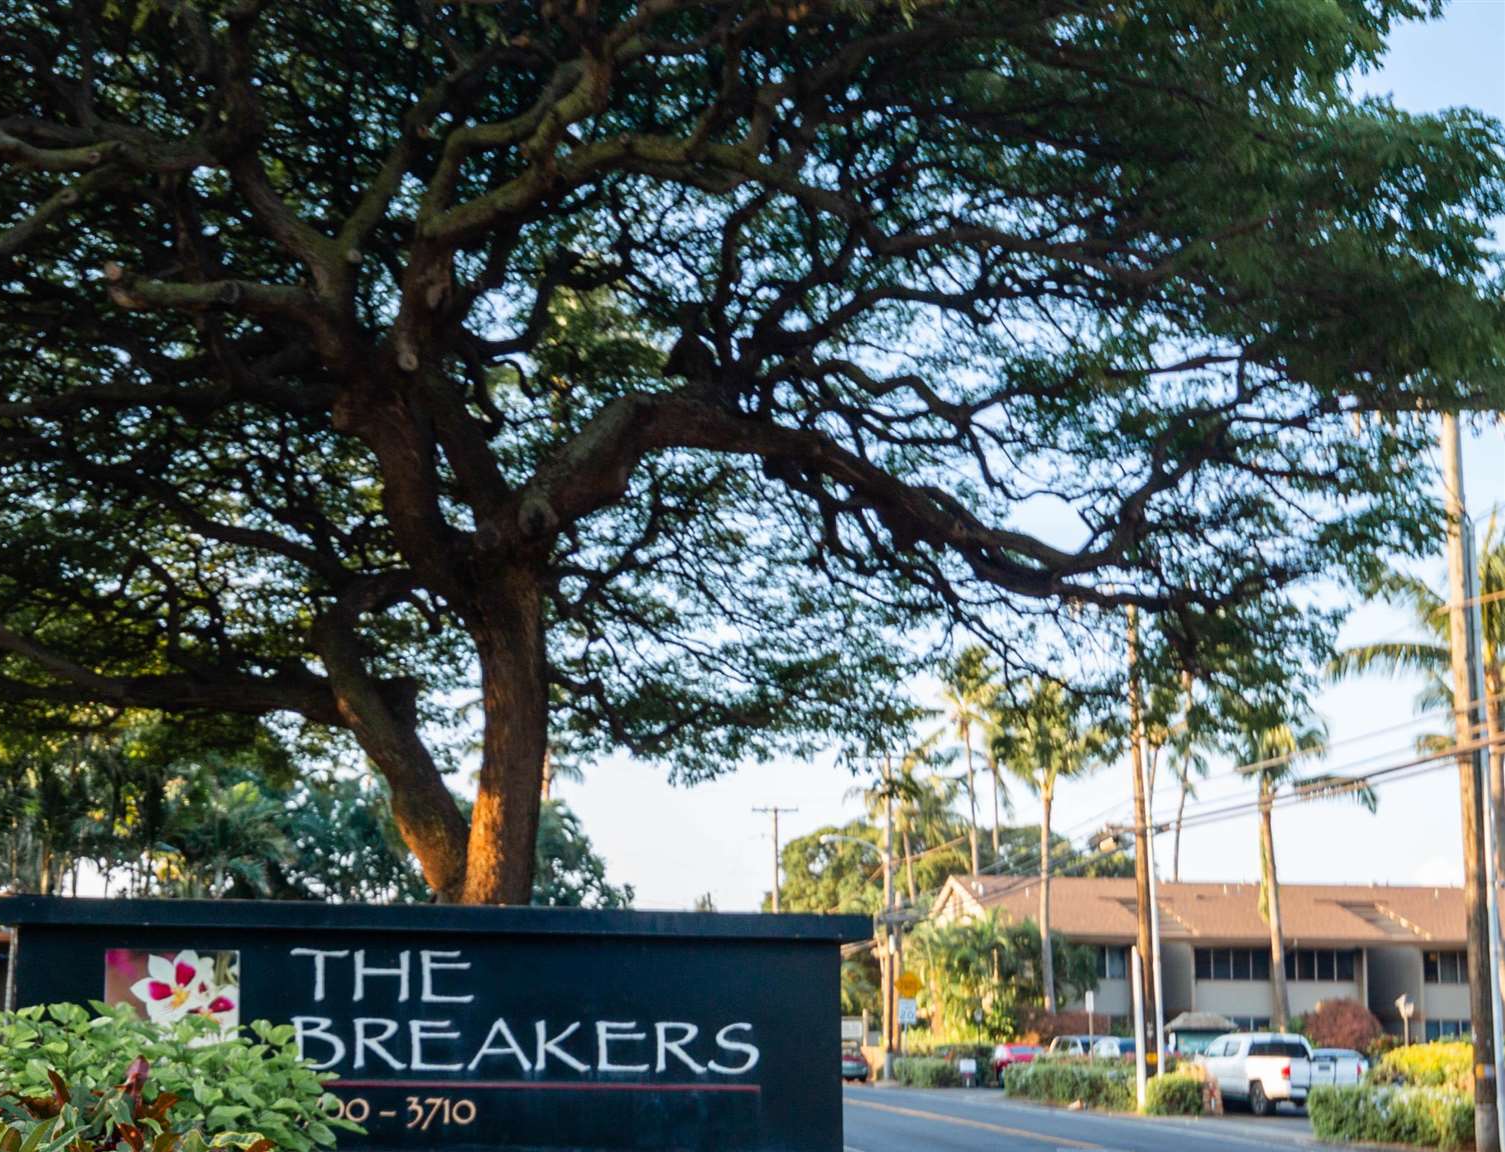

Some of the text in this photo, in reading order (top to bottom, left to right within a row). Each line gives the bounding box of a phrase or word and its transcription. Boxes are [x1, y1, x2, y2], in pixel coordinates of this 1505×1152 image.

[290, 947, 475, 1003] THE
[290, 1015, 760, 1074] BREAKERS
[406, 1097, 477, 1131] 3710
